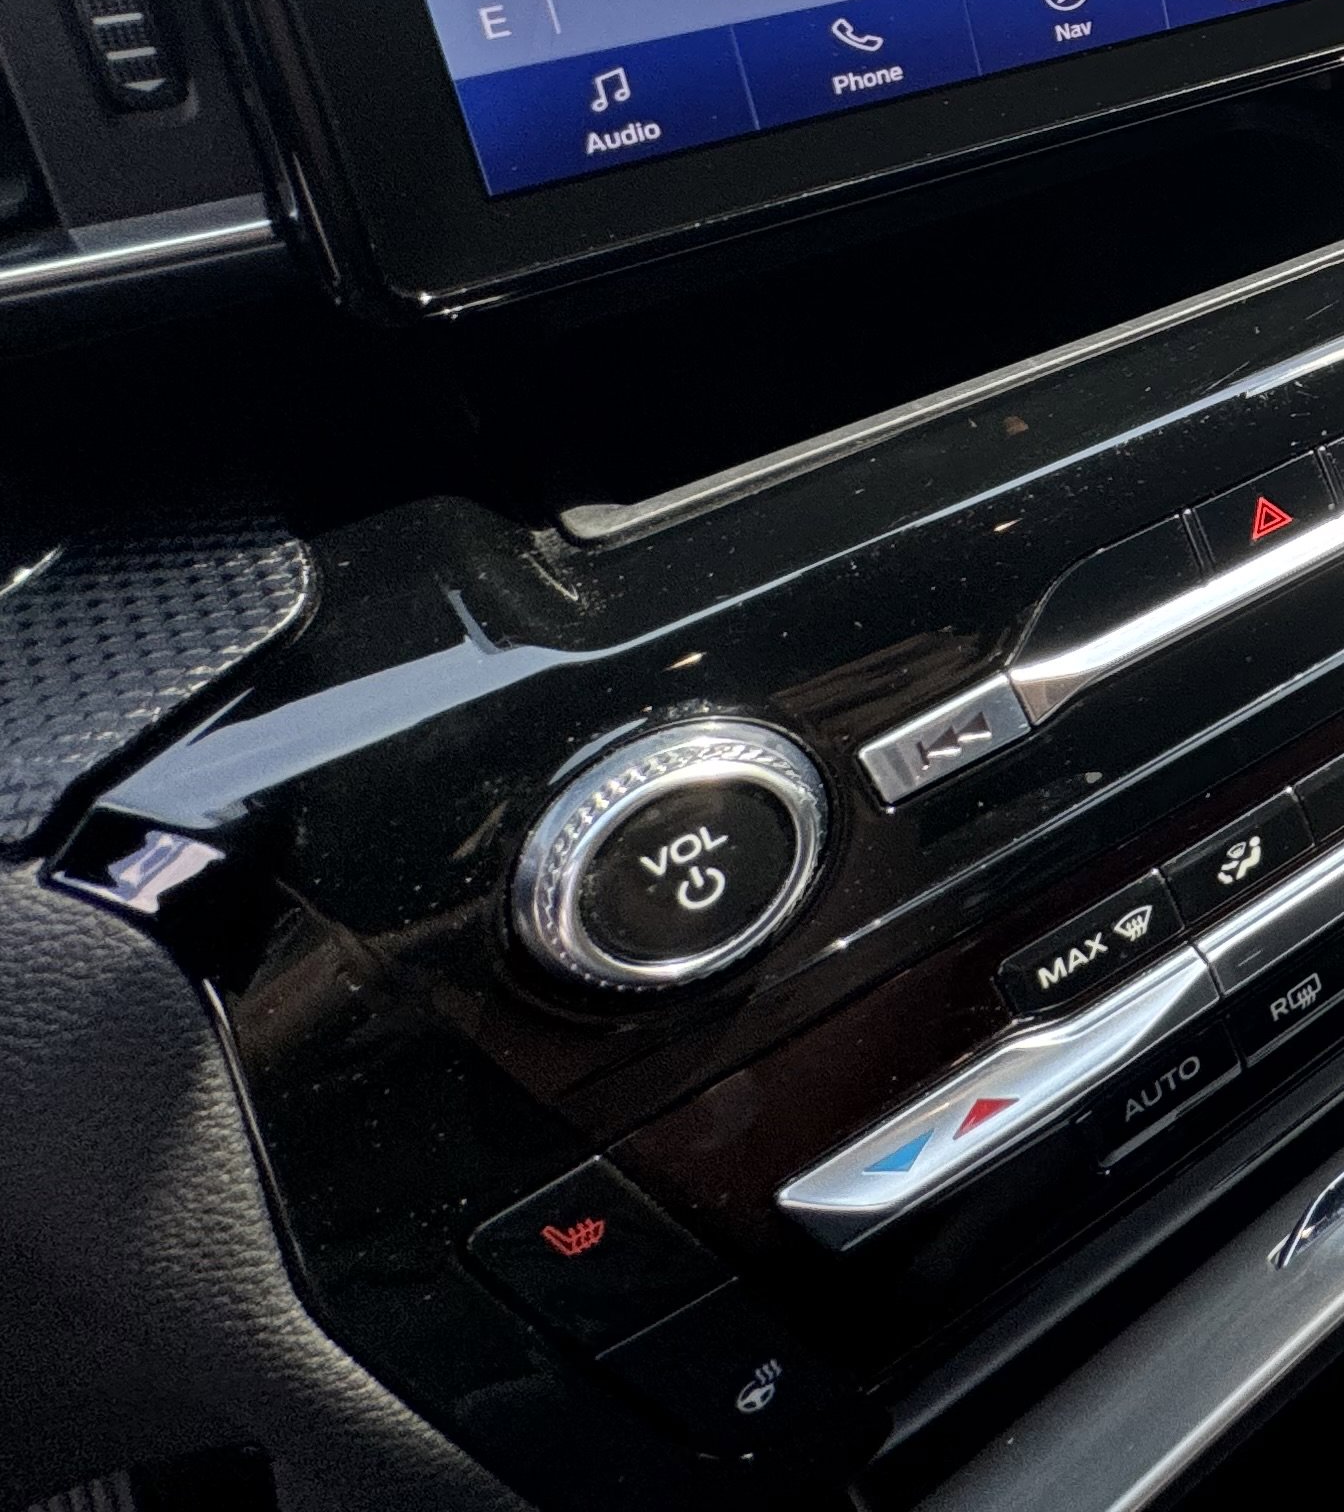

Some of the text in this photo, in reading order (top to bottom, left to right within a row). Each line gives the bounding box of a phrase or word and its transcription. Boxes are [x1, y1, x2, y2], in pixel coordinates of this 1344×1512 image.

[479, 6, 511, 40] E
[1055, 19, 1092, 41] Nav
[833, 64, 903, 94] Phone
[585, 118, 661, 155] Audio
[638, 826, 728, 877] VOL
[1037, 932, 1108, 989] MAX
[1125, 1056, 1201, 1123] AUTO
